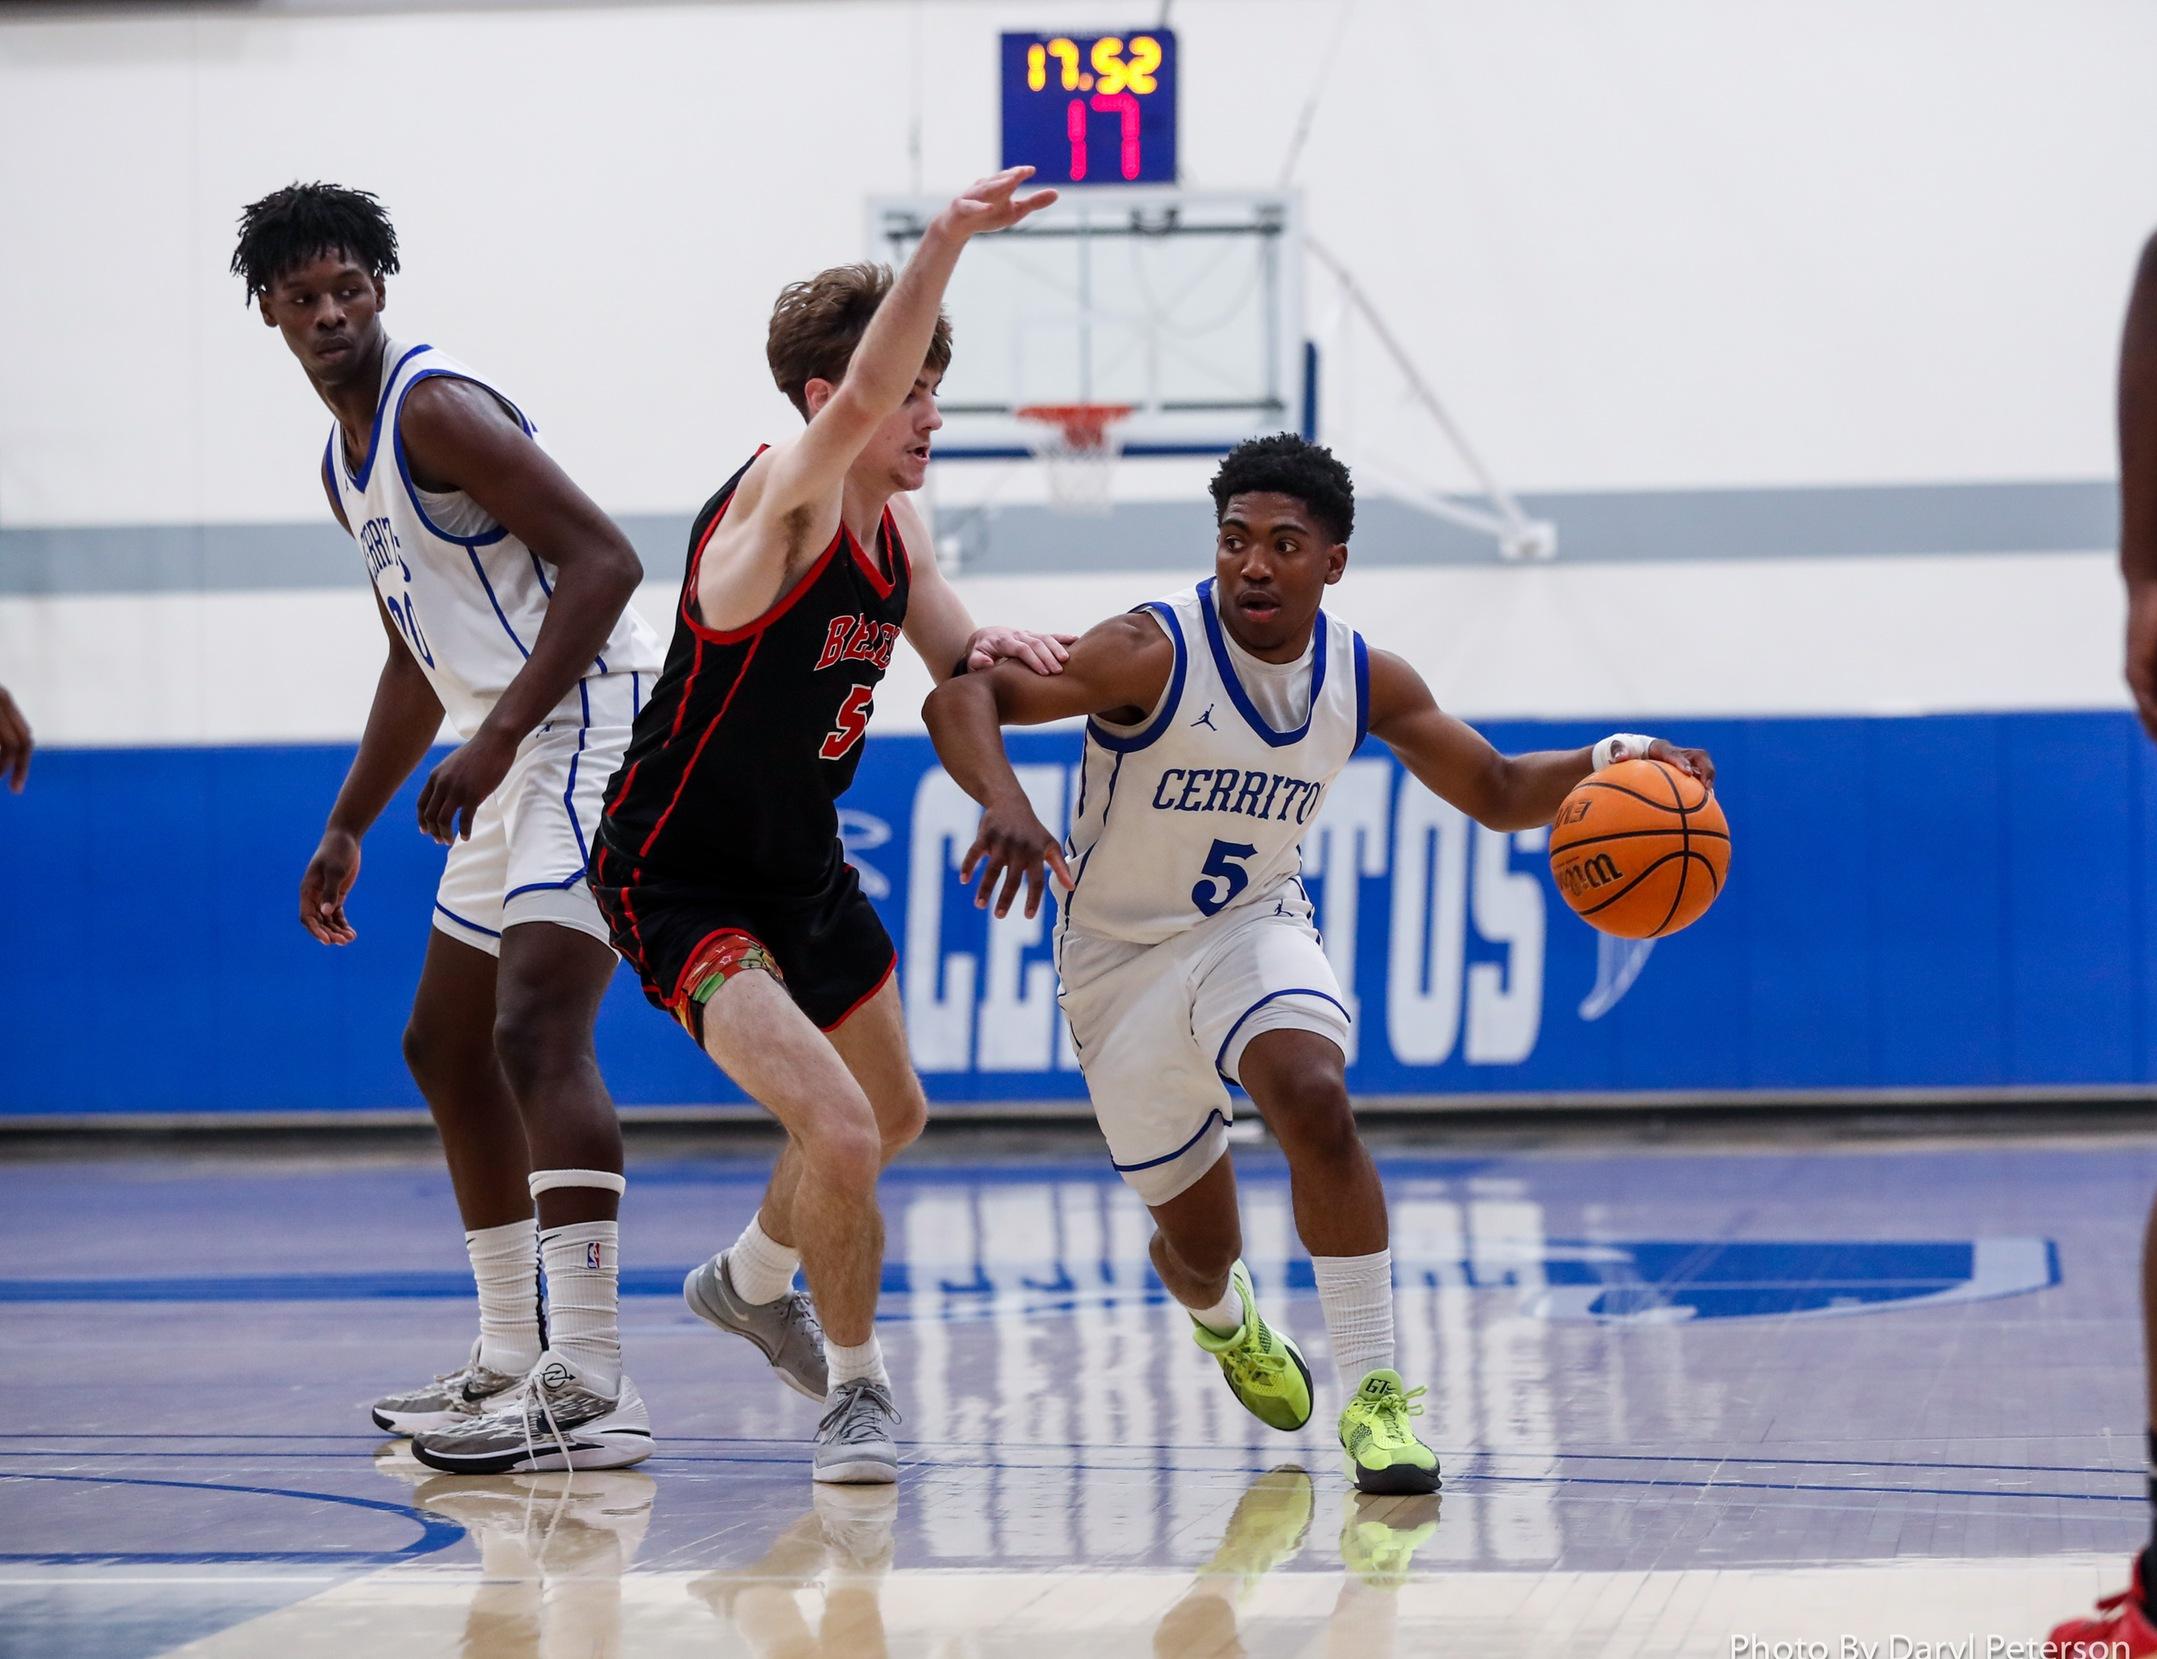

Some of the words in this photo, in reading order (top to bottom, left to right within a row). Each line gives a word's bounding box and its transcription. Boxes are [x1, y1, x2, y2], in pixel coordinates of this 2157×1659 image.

[1067, 92, 1141, 182] 17
[819, 683, 874, 761] 5
[1152, 768, 1326, 825] CERRITO
[904, 755, 1547, 1073] CETOS
[1191, 838, 1258, 917] 5
